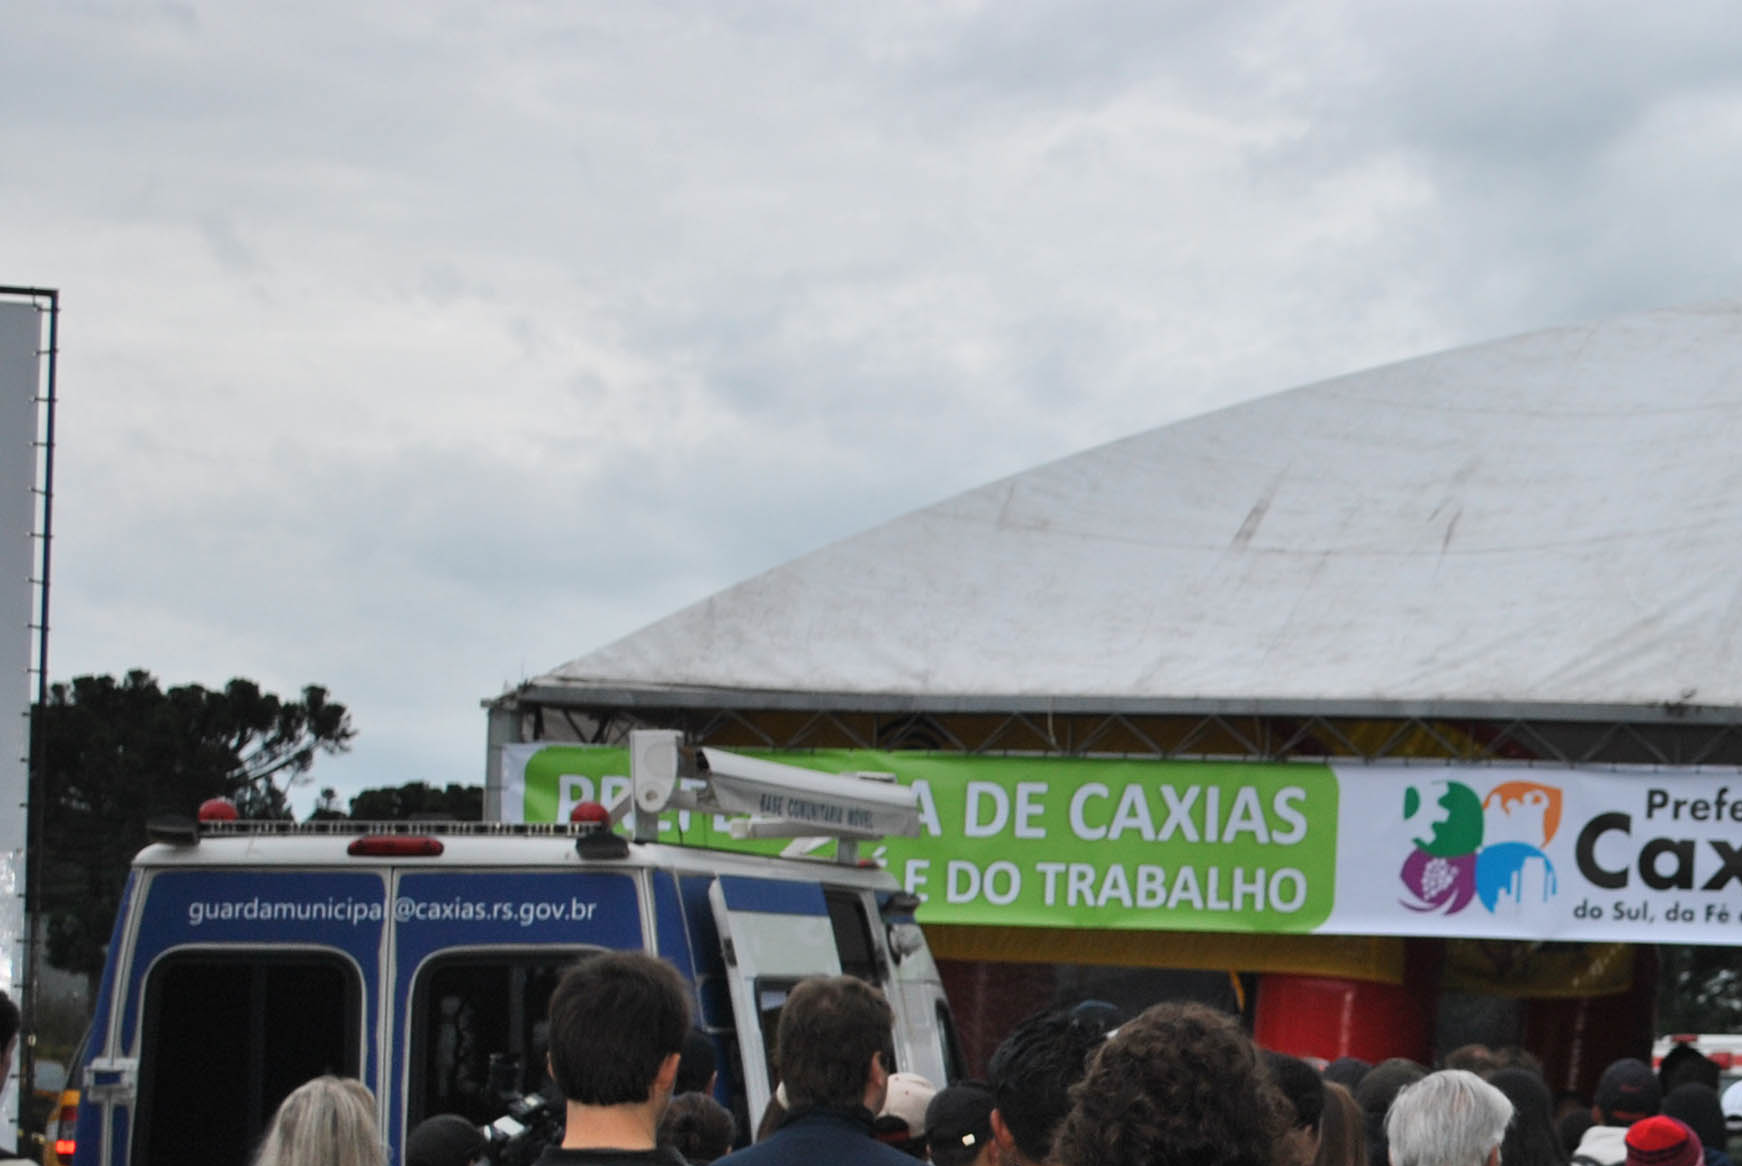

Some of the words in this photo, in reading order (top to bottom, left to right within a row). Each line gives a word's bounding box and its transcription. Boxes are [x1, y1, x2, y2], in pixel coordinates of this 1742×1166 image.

[964, 781, 1048, 838] DE
[1069, 783, 1308, 845] CAXIAS
[947, 860, 1021, 905] DO
[1036, 862, 1308, 913] TRABALHO
[1574, 899, 1603, 919] do
[1613, 901, 1655, 923] Sul,
[1665, 902, 1695, 922] da
[1705, 903, 1729, 924] Fé
